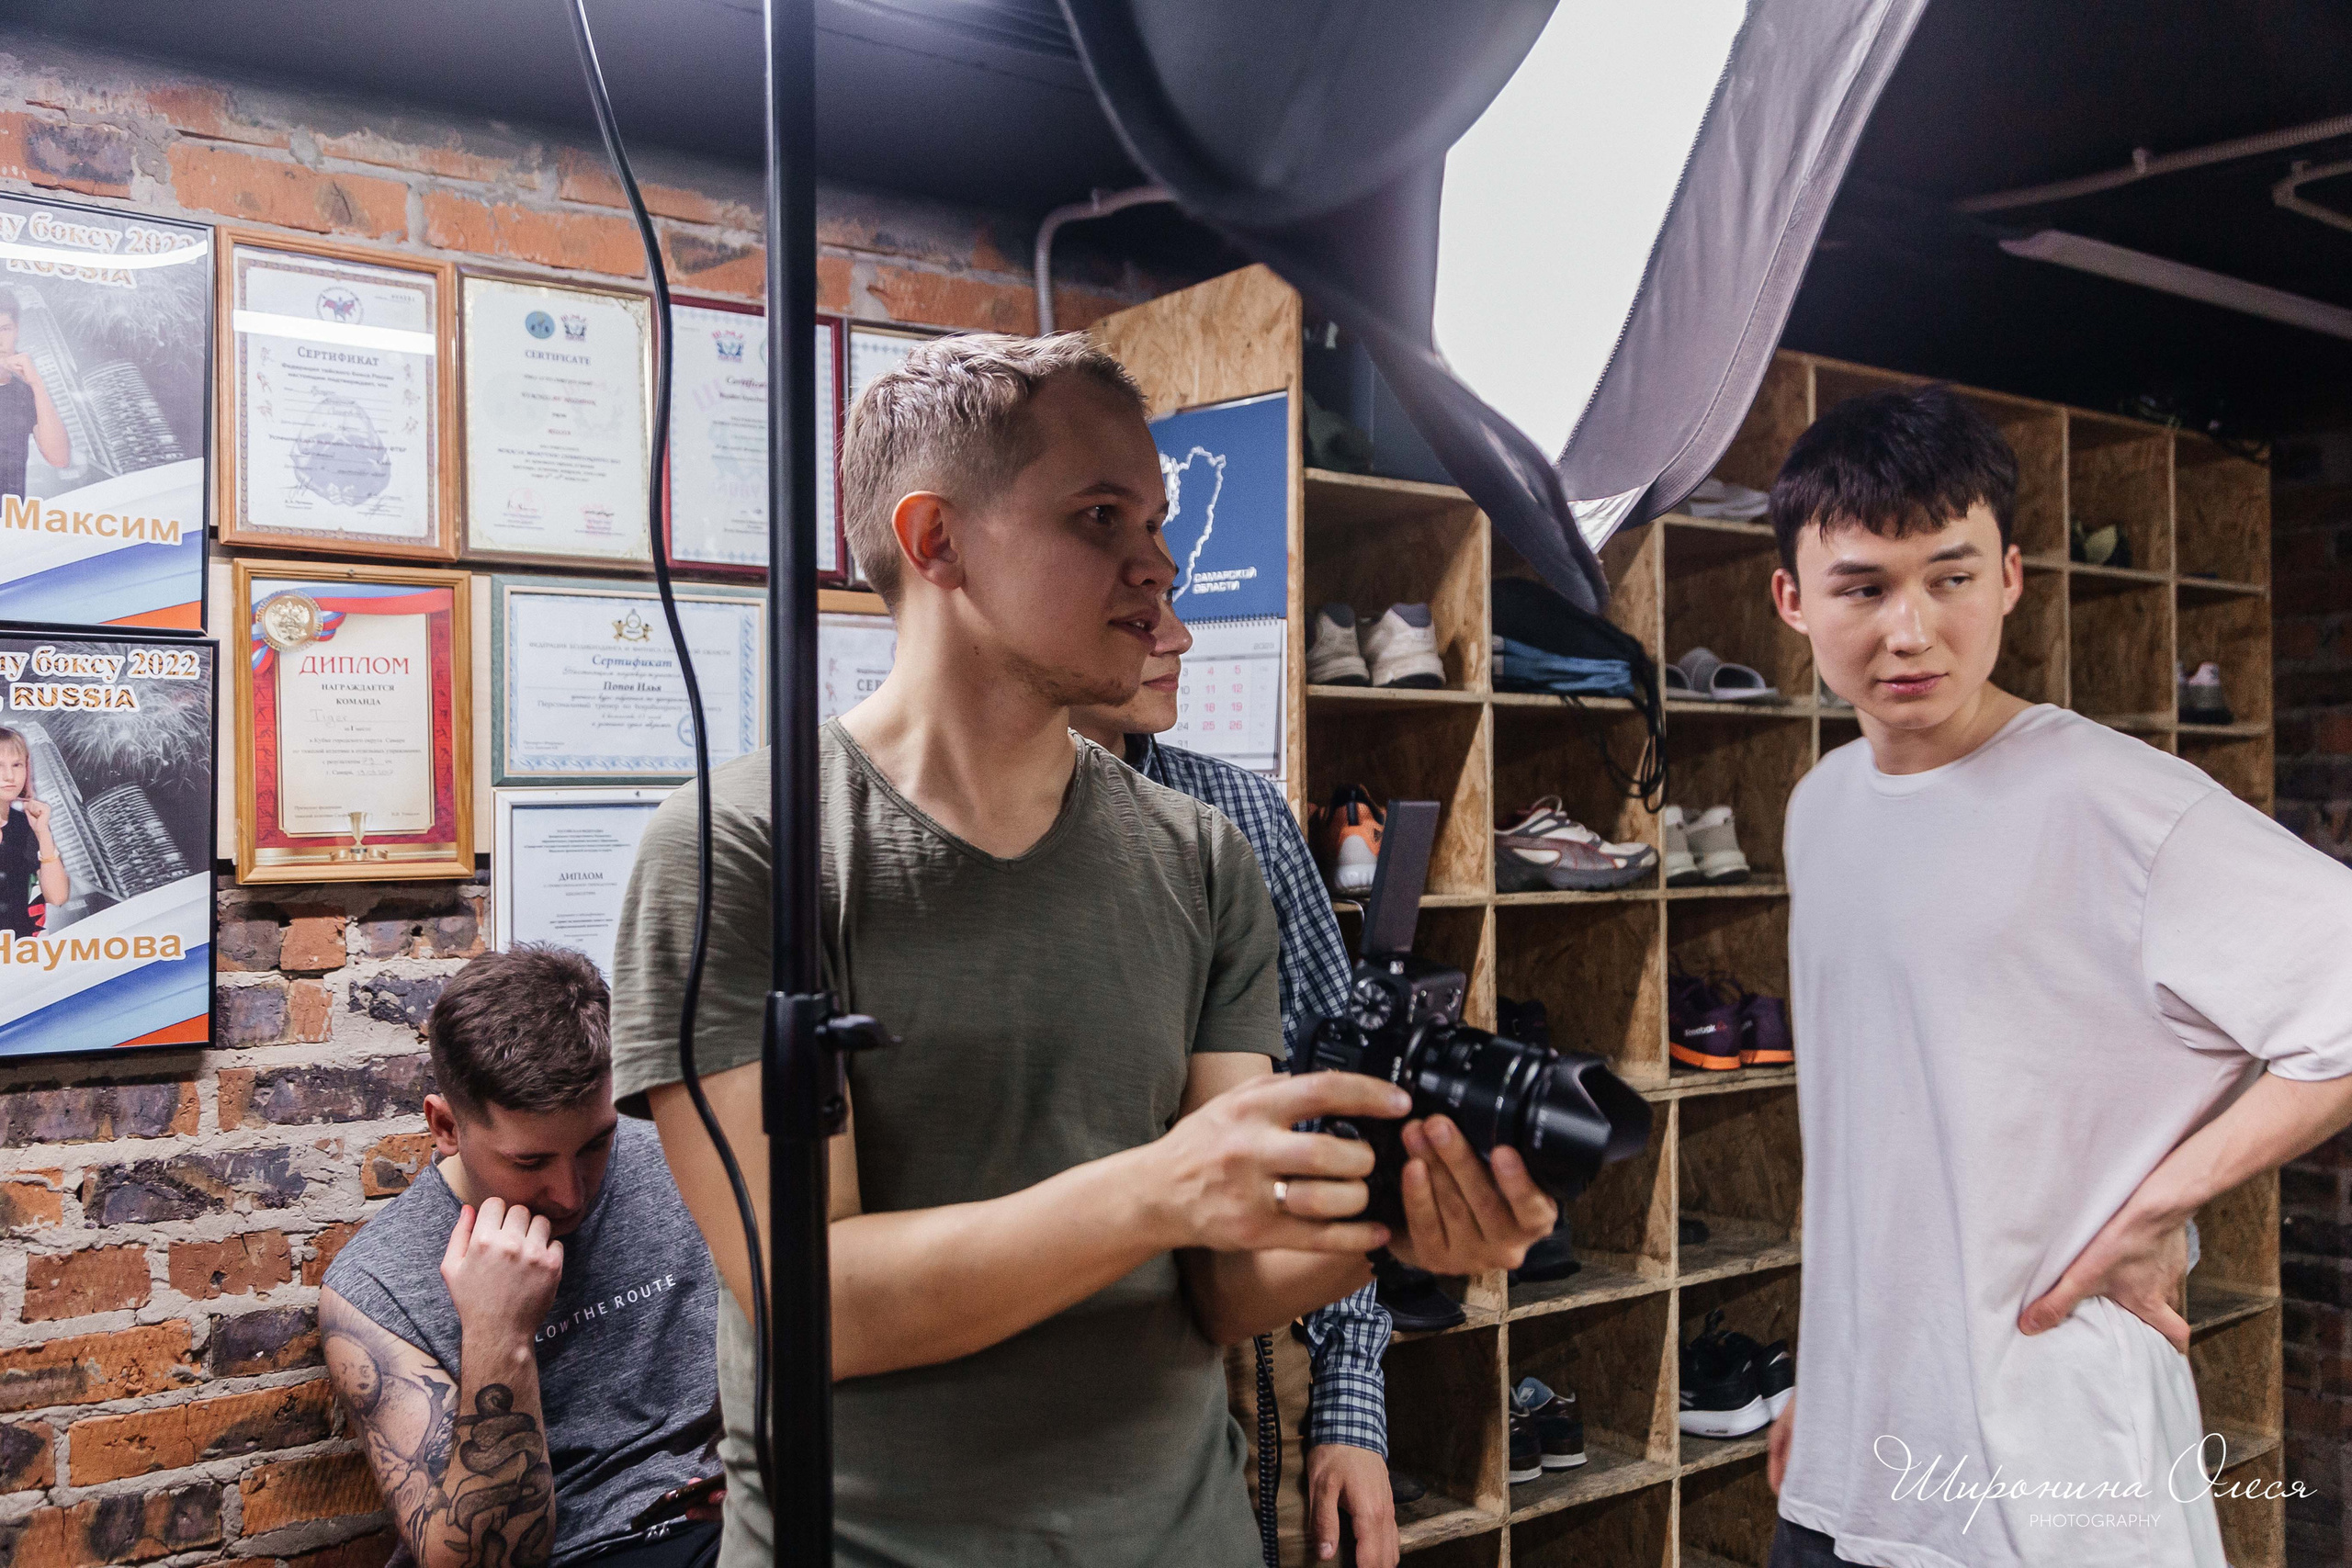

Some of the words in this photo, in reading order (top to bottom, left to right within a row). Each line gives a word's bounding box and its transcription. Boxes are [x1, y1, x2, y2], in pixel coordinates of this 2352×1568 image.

[32, 215, 117, 254] боксу
[525, 349, 592, 366] CERTIFICATE
[5, 497, 180, 542] Максим
[1193, 567, 1257, 582] САМАРСКОЙ
[1193, 581, 1240, 594] ОБЛАСТИ
[35, 649, 121, 680] боксу
[130, 652, 198, 676] 2022
[299, 655, 411, 677] ДИПЛОМ
[592, 653, 673, 669] Сертификат
[604, 681, 635, 692] Попов
[856, 679, 883, 691] СЕР
[1180, 685, 1191, 695] 10
[1205, 684, 1216, 694] 11
[1232, 683, 1243, 694] 12
[14, 686, 137, 708] RUSSIA
[1180, 703, 1190, 713] 17
[1231, 702, 1243, 712] 19
[1177, 722, 1189, 731] 24
[1203, 721, 1216, 731] 25
[1229, 720, 1243, 731] 26
[559, 872, 604, 882] ДИПЛОМ
[1684, 1023, 1716, 1037] Reebok
[535, 1319, 570, 1342] LOW
[573, 1302, 608, 1325] THE
[614, 1273, 676, 1309] ROUTE
